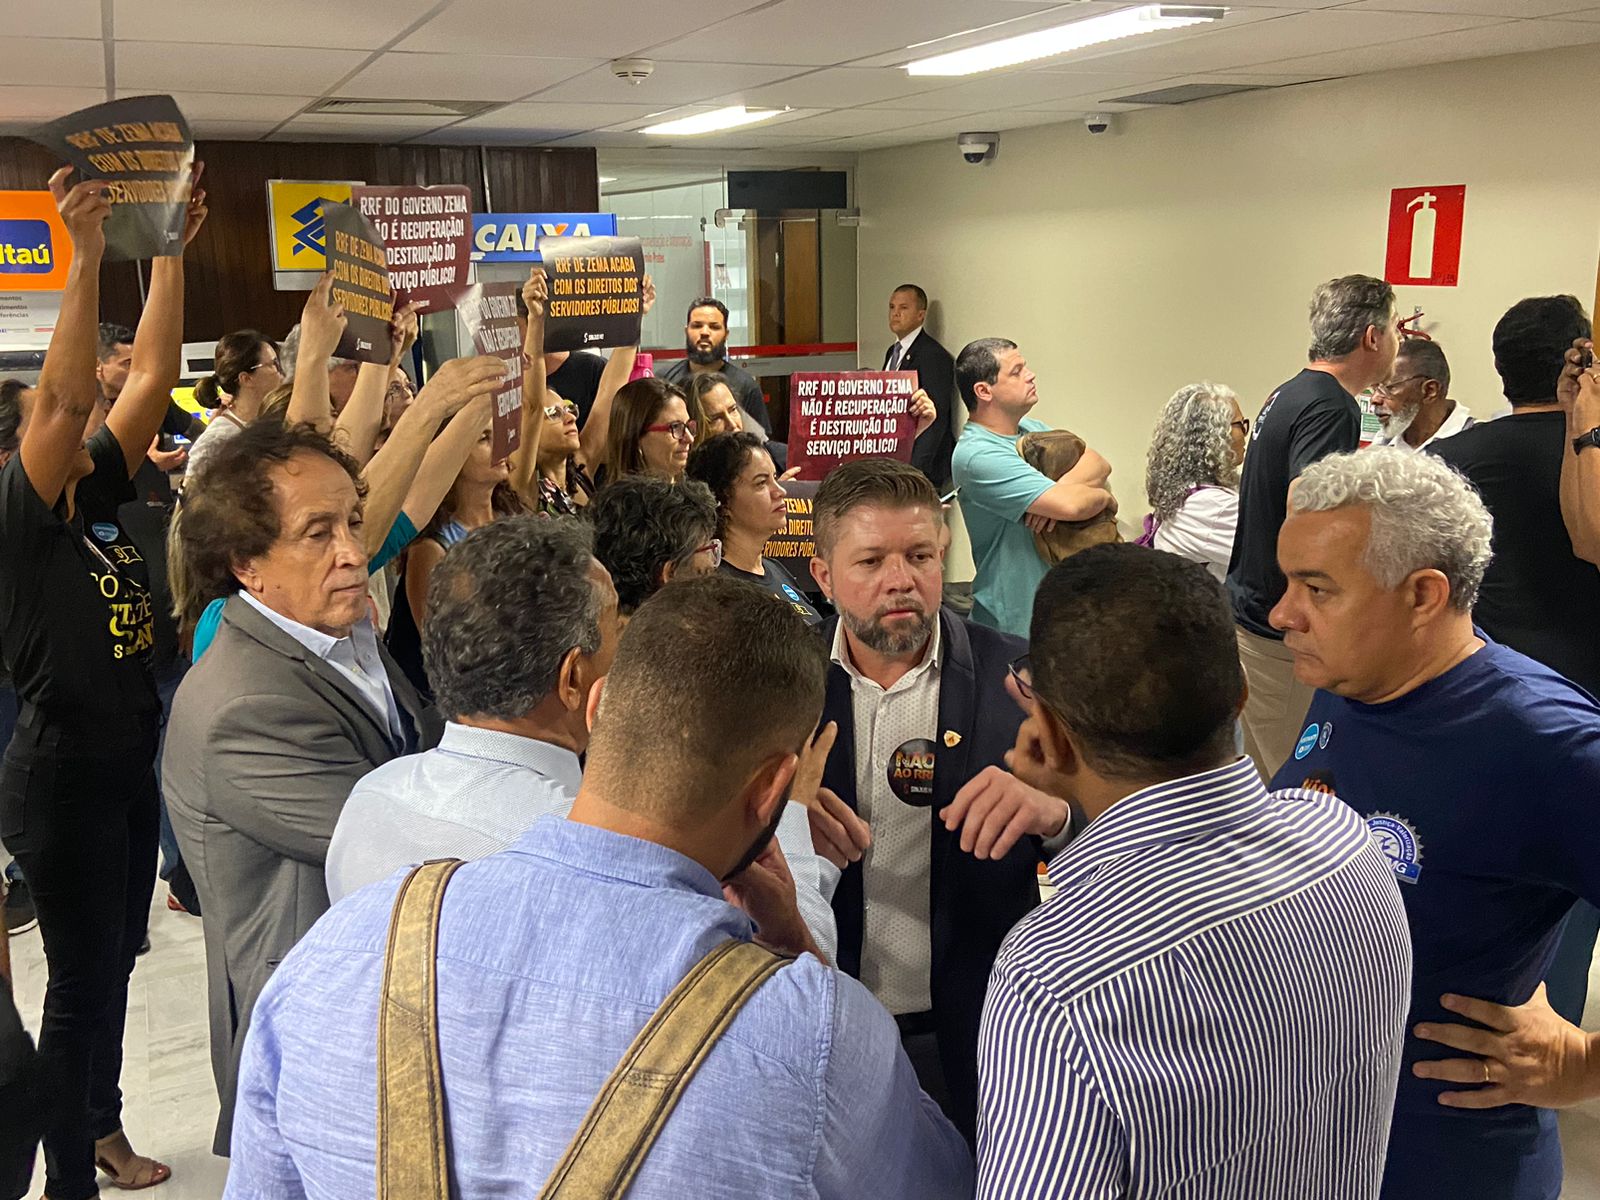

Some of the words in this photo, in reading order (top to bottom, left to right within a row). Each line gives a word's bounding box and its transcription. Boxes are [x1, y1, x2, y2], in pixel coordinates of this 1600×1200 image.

[360, 196, 382, 215] RRF
[385, 196, 400, 216] DO
[402, 196, 443, 215] GOVERNO
[444, 195, 468, 213] ZEMA
[391, 218, 398, 240] É
[400, 216, 464, 242] RECUPERAÇÃO!
[0, 243, 50, 265] Itaú
[386, 241, 443, 269] DESTRUIÇÃO
[445, 243, 456, 261] DO
[554, 257, 571, 273] RRF
[573, 257, 585, 272] DE
[586, 256, 610, 272] ZEMA
[610, 256, 636, 272] ACABA
[388, 270, 418, 293] RVIÇO
[420, 266, 456, 288] PÚBLICO!
[554, 278, 573, 295] COM
[574, 278, 585, 294] OS
[587, 277, 622, 294] DIREITOS
[623, 277, 638, 293] DOS
[550, 299, 600, 317] SERVIDORES
[601, 296, 640, 314] PÚBLICOS!
[798, 380, 819, 396] RRF
[821, 380, 835, 396] DO
[838, 380, 883, 396] GOVERNO
[886, 379, 913, 394] ZEMA
[801, 398, 822, 416] NÃO
[825, 398, 833, 416] É
[835, 397, 908, 418] RECUPERAÇÃO!
[810, 418, 817, 436] É
[819, 417, 881, 440] DESTRUIÇÃO
[883, 419, 897, 433] DO
[806, 440, 851, 459] SERVIÇO
[853, 438, 898, 455] PÚBLICO!
[784, 498, 809, 514] ZEMA
[788, 519, 814, 536] DIREIT
[763, 541, 799, 557] RVIDORES
[894, 768, 912, 778] AO
